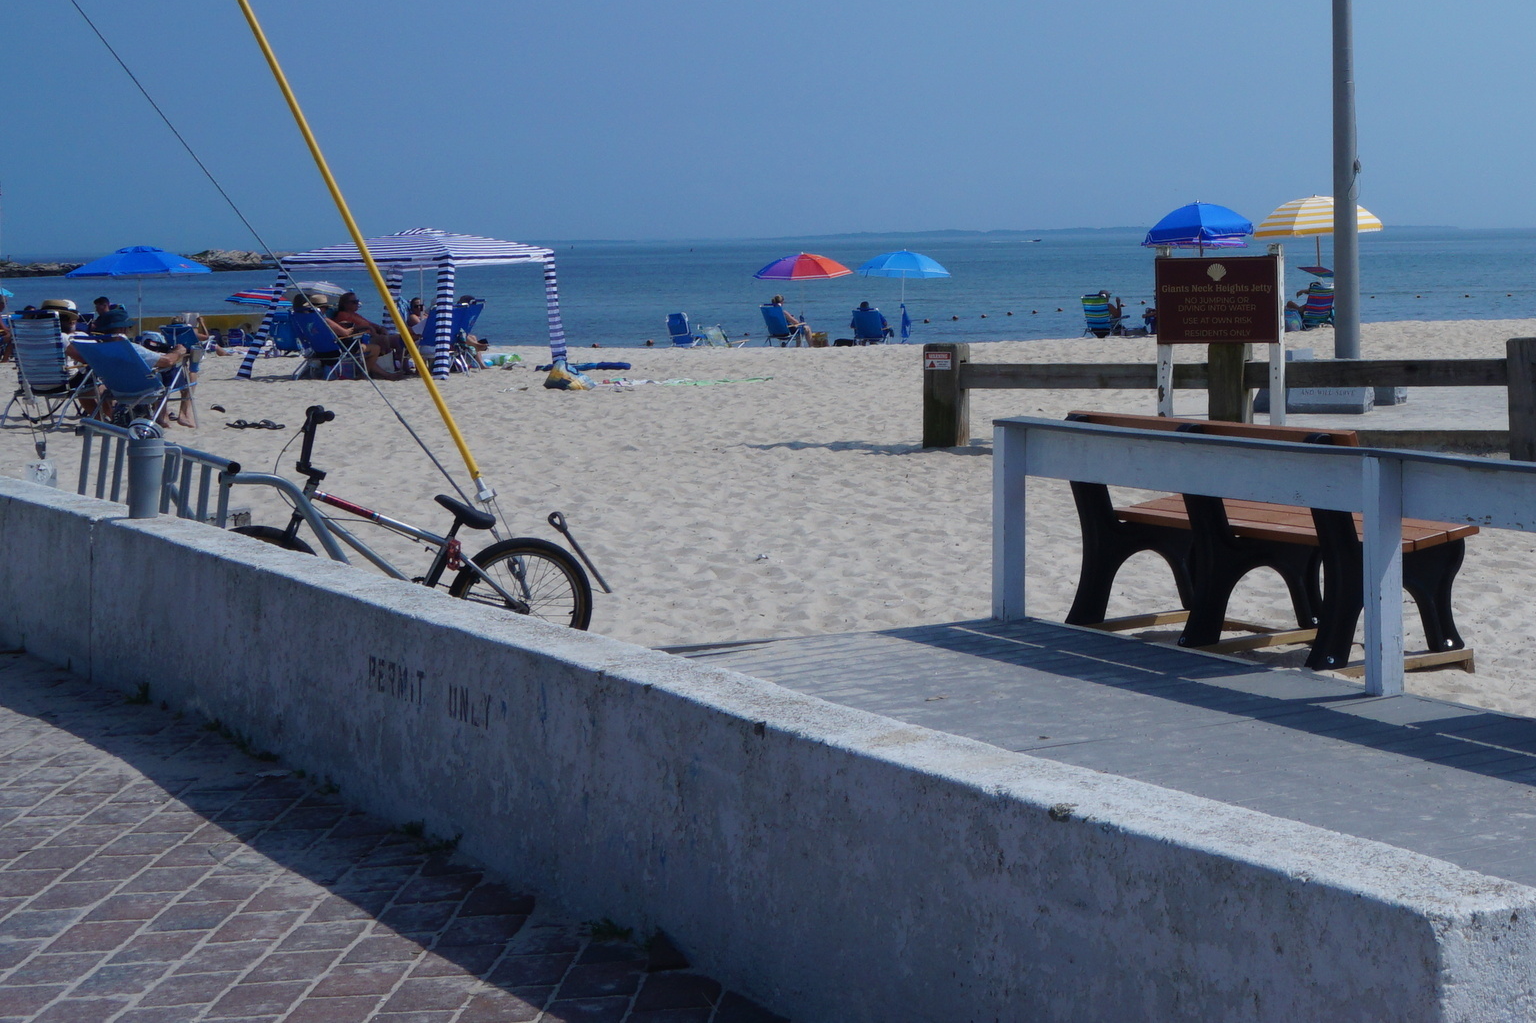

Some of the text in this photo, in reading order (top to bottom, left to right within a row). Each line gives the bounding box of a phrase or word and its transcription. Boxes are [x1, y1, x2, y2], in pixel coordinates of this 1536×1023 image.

[1161, 283, 1272, 294] Giants Neck Heights Jetty
[1199, 296, 1235, 304] JUMPING
[1237, 296, 1250, 304] OR
[1207, 304, 1227, 312] INTO
[1182, 317, 1198, 325] USE
[1211, 316, 1232, 324] OWN
[1234, 316, 1252, 324] RISK
[1184, 329, 1228, 337] RESIDENTS
